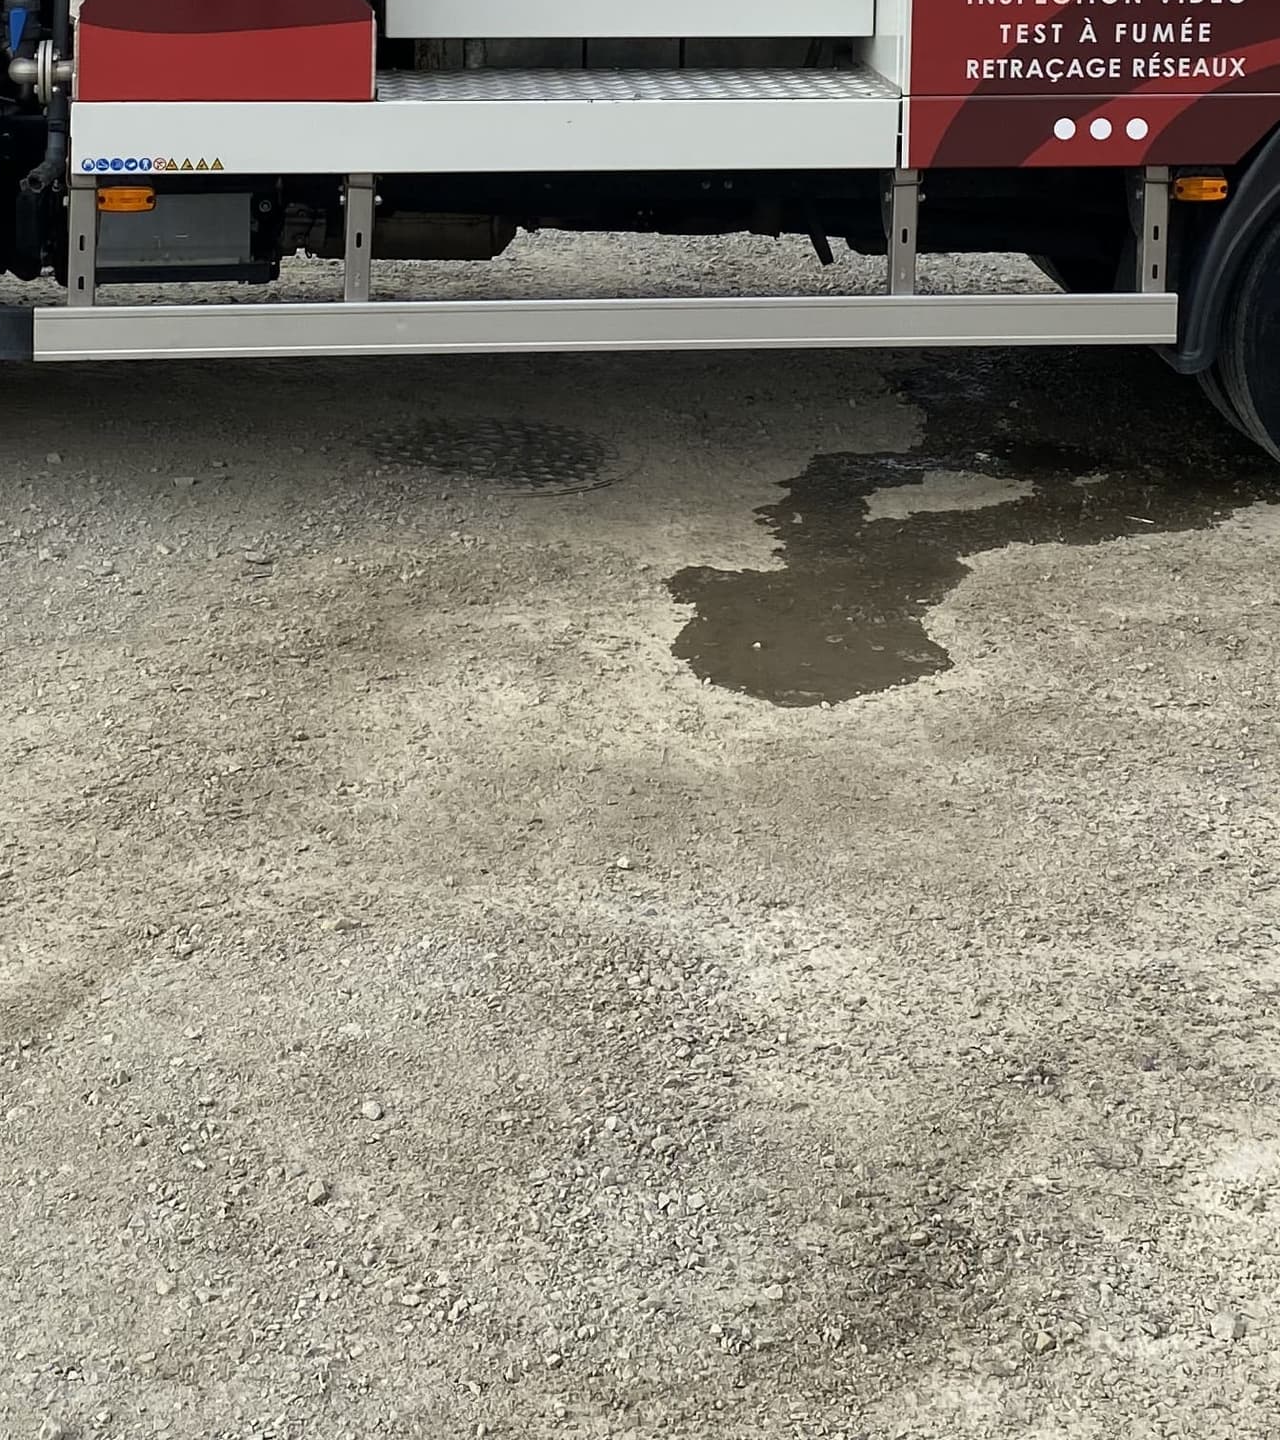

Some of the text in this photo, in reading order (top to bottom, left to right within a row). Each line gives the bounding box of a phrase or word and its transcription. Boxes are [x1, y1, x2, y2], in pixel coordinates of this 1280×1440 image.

[1000, 17, 1211, 44] TEST À FUMÉE
[966, 52, 1245, 83] RETRAÇAGE RÉSEAUX
